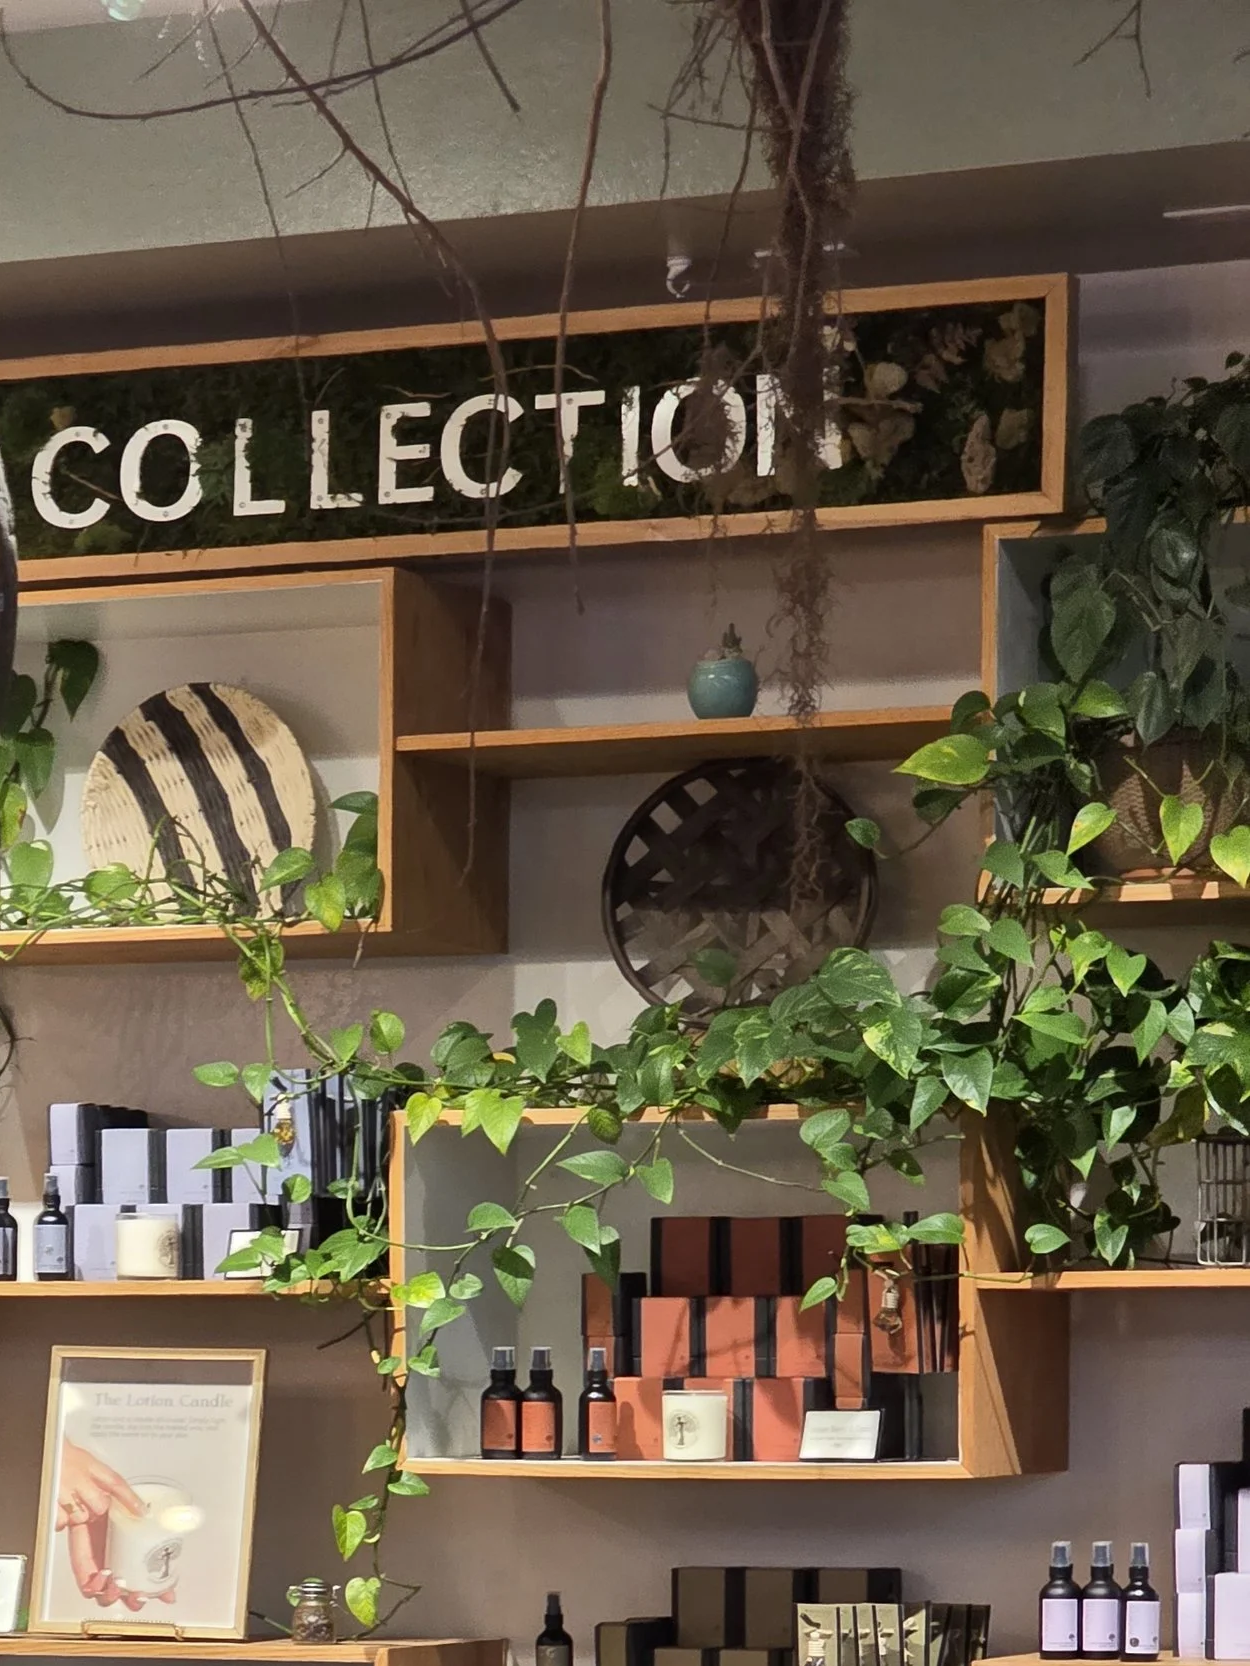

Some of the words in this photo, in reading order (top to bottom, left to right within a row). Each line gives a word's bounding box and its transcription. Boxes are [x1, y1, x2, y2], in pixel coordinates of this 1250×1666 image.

[32, 366, 843, 529] COLLECTION
[95, 1392, 122, 1407] The
[125, 1393, 174, 1407] Lotion
[179, 1393, 233, 1408] Candle
